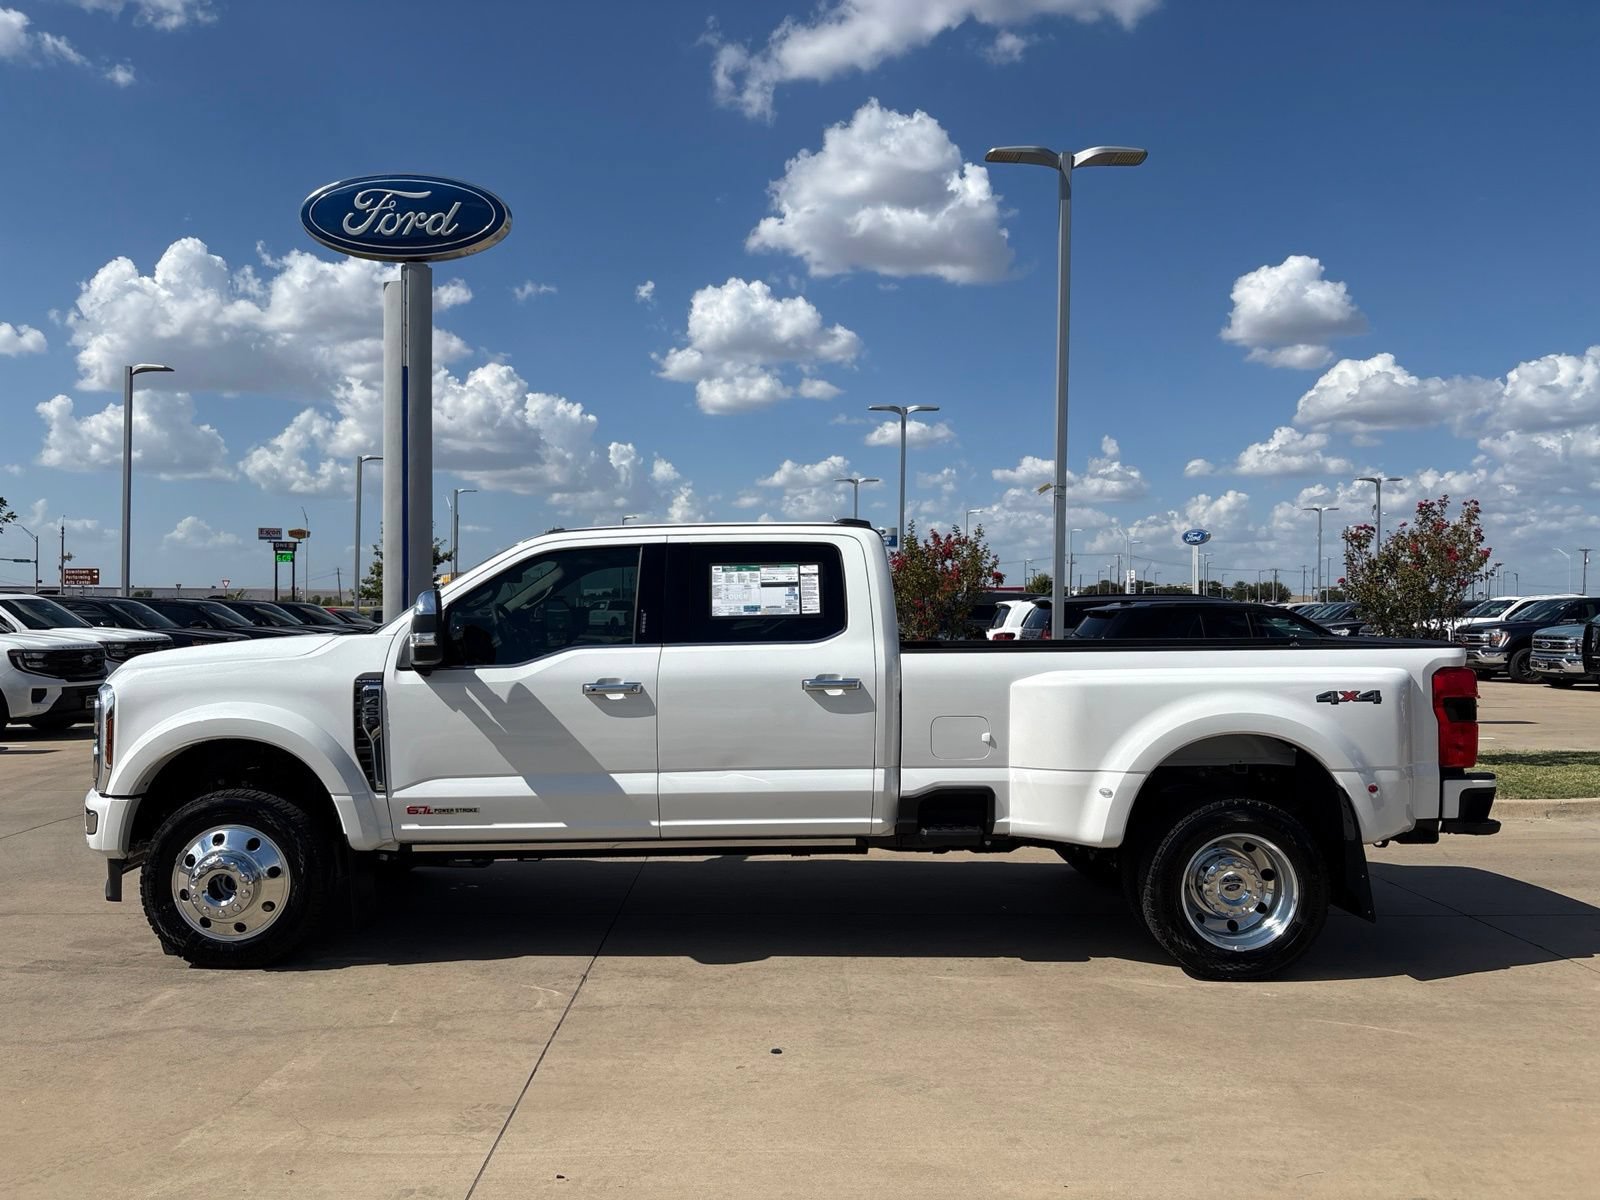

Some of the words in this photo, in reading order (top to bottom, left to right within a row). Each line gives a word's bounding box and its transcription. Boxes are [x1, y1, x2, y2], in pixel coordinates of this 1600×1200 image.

[342, 188, 462, 236] Ford
[260, 529, 281, 537] Exxon
[1186, 532, 1202, 541] Ford
